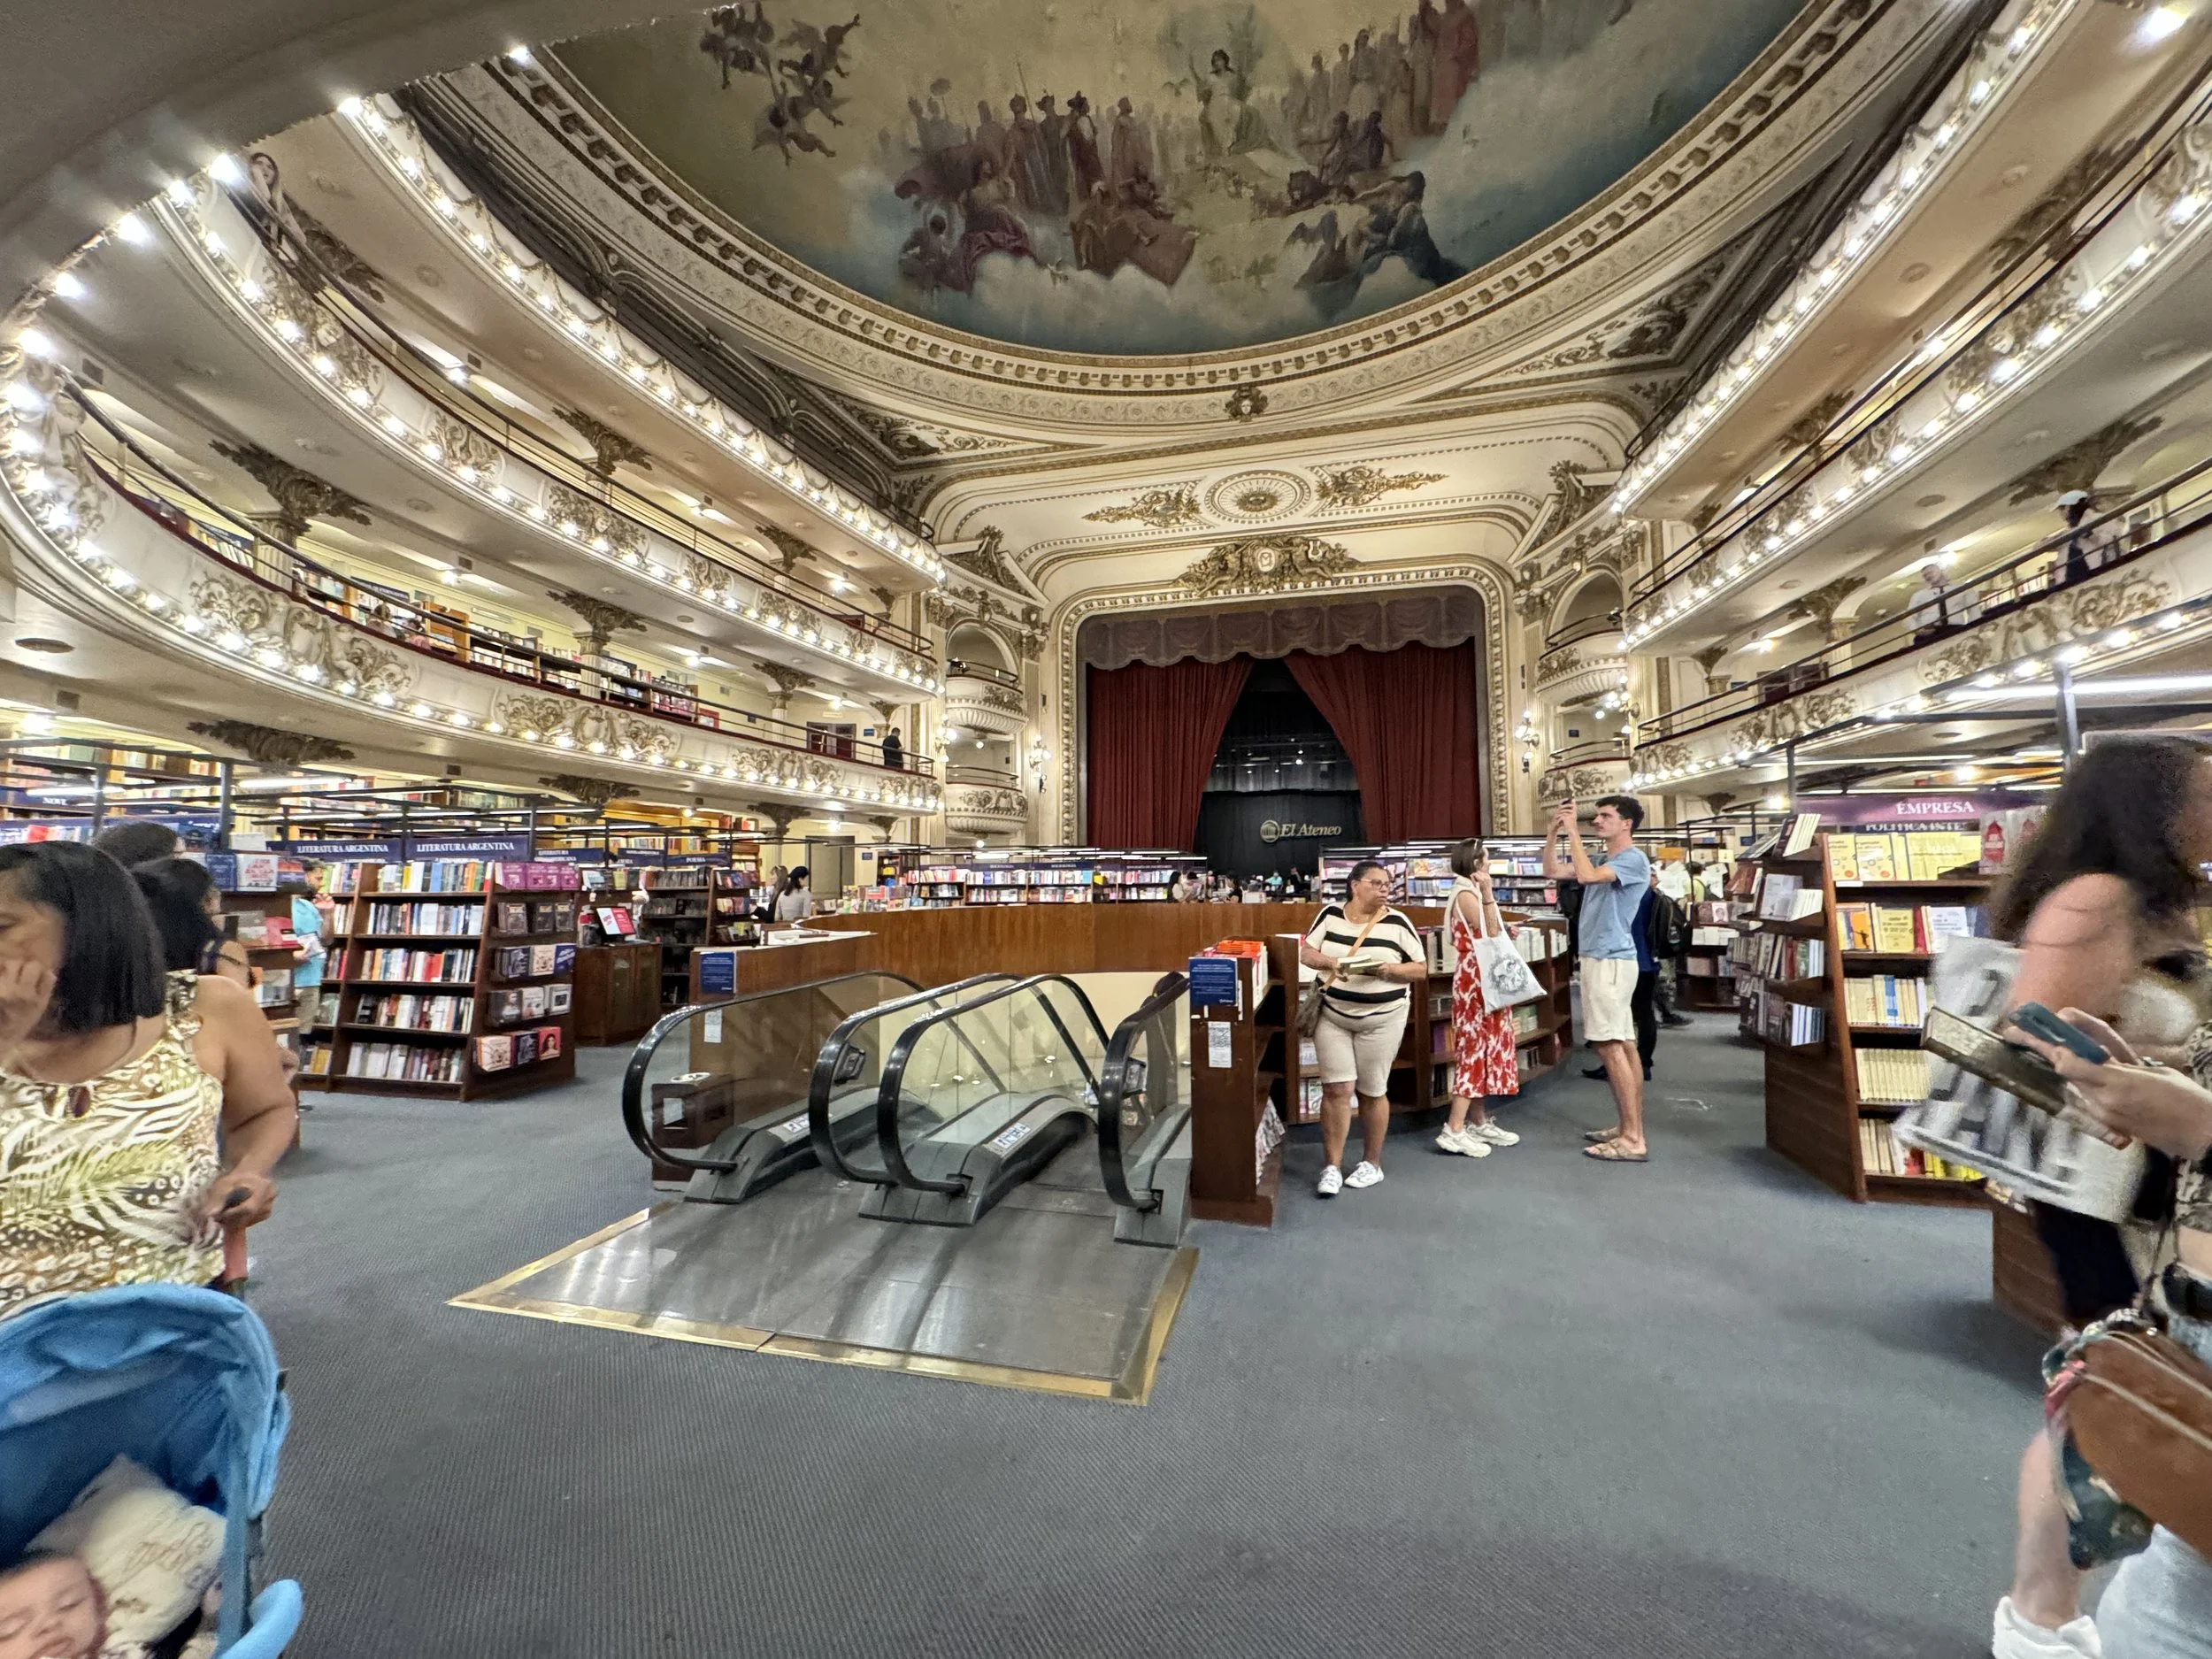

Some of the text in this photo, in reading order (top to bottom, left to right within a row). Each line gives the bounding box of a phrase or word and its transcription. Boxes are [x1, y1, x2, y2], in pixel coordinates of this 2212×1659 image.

[1896, 802, 1975, 814] EMPRESA
[1279, 823, 1342, 837] El Ateneo
[296, 845, 344, 854] LITERATURA
[416, 841, 515, 852] LITERATURA ARGENTINA
